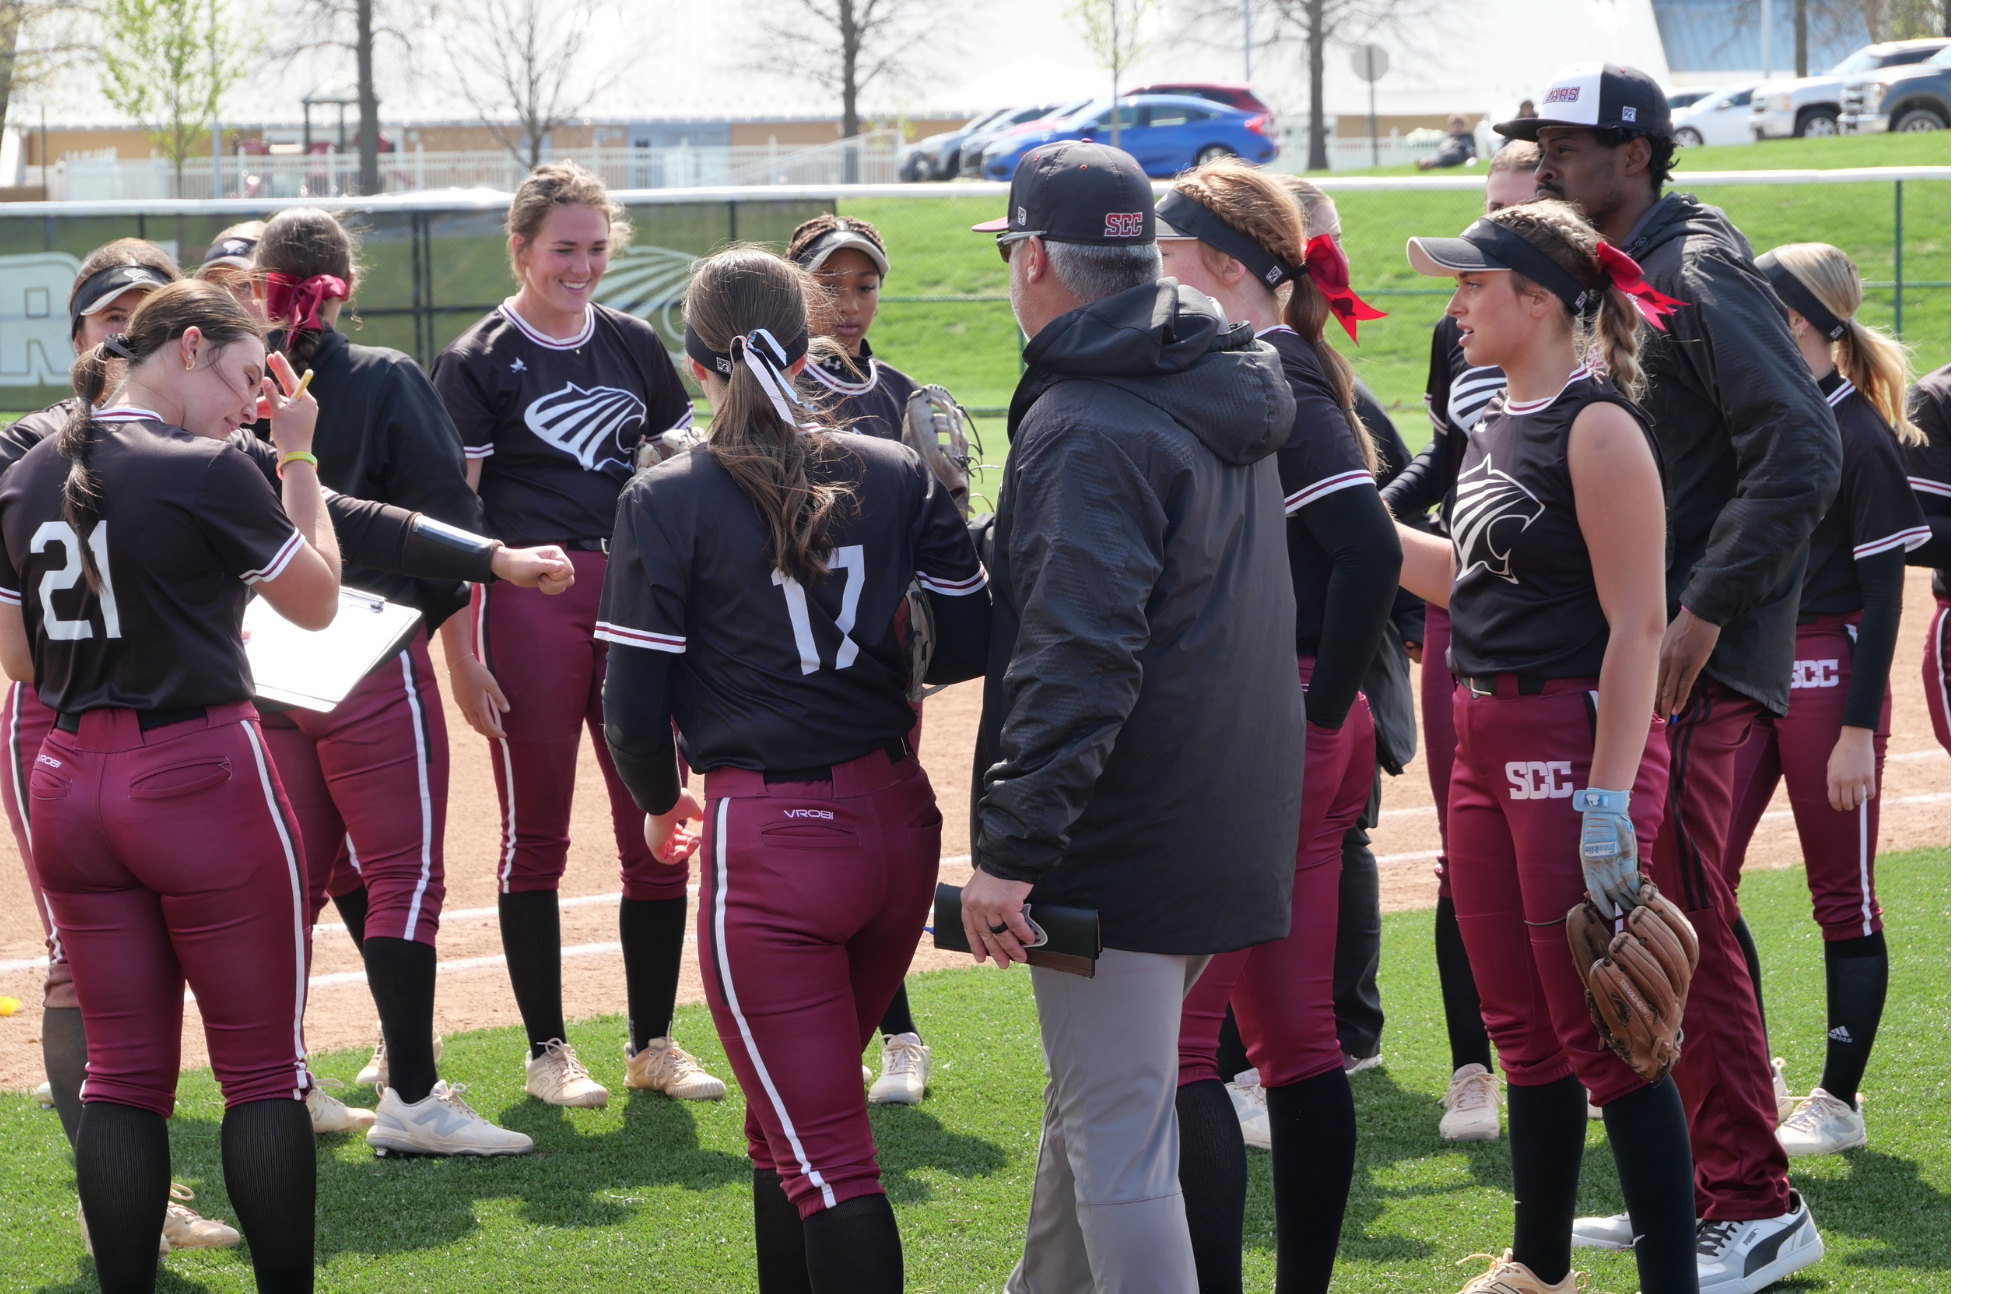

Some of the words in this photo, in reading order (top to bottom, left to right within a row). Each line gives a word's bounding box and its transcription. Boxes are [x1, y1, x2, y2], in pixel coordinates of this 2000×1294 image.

[1104, 212, 1142, 237] SCC
[30, 520, 122, 640] 21
[771, 544, 865, 675] 17
[1505, 761, 1574, 800] SCC
[783, 809, 834, 820] VROBI
